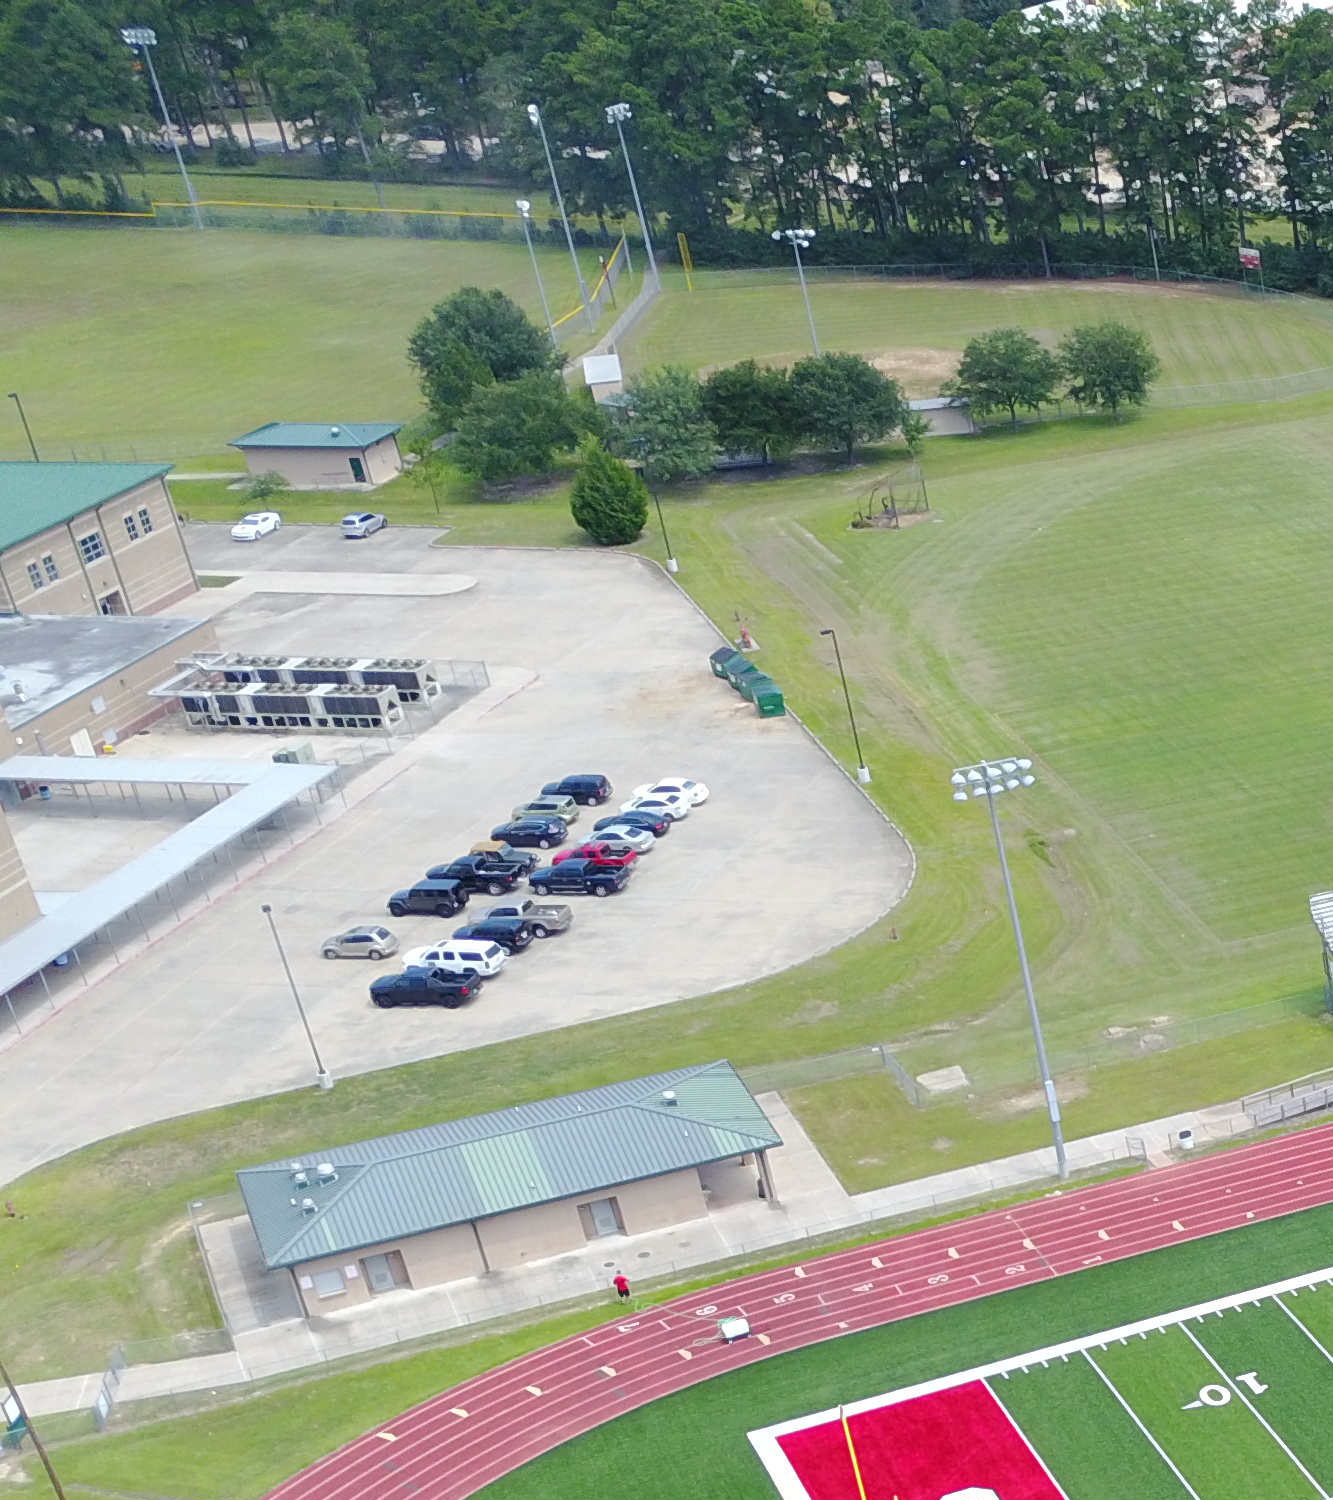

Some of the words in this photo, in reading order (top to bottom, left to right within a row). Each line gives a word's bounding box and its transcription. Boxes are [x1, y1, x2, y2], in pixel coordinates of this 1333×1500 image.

[617, 1320, 640, 1333] 7
[695, 1304, 718, 1317] 6
[773, 1292, 796, 1305] 5
[852, 1280, 874, 1293] 4
[927, 1273, 950, 1285] 3
[1004, 1263, 1026, 1275] 2
[1082, 1254, 1103, 1266] 1
[1200, 1371, 1269, 1407] 10
